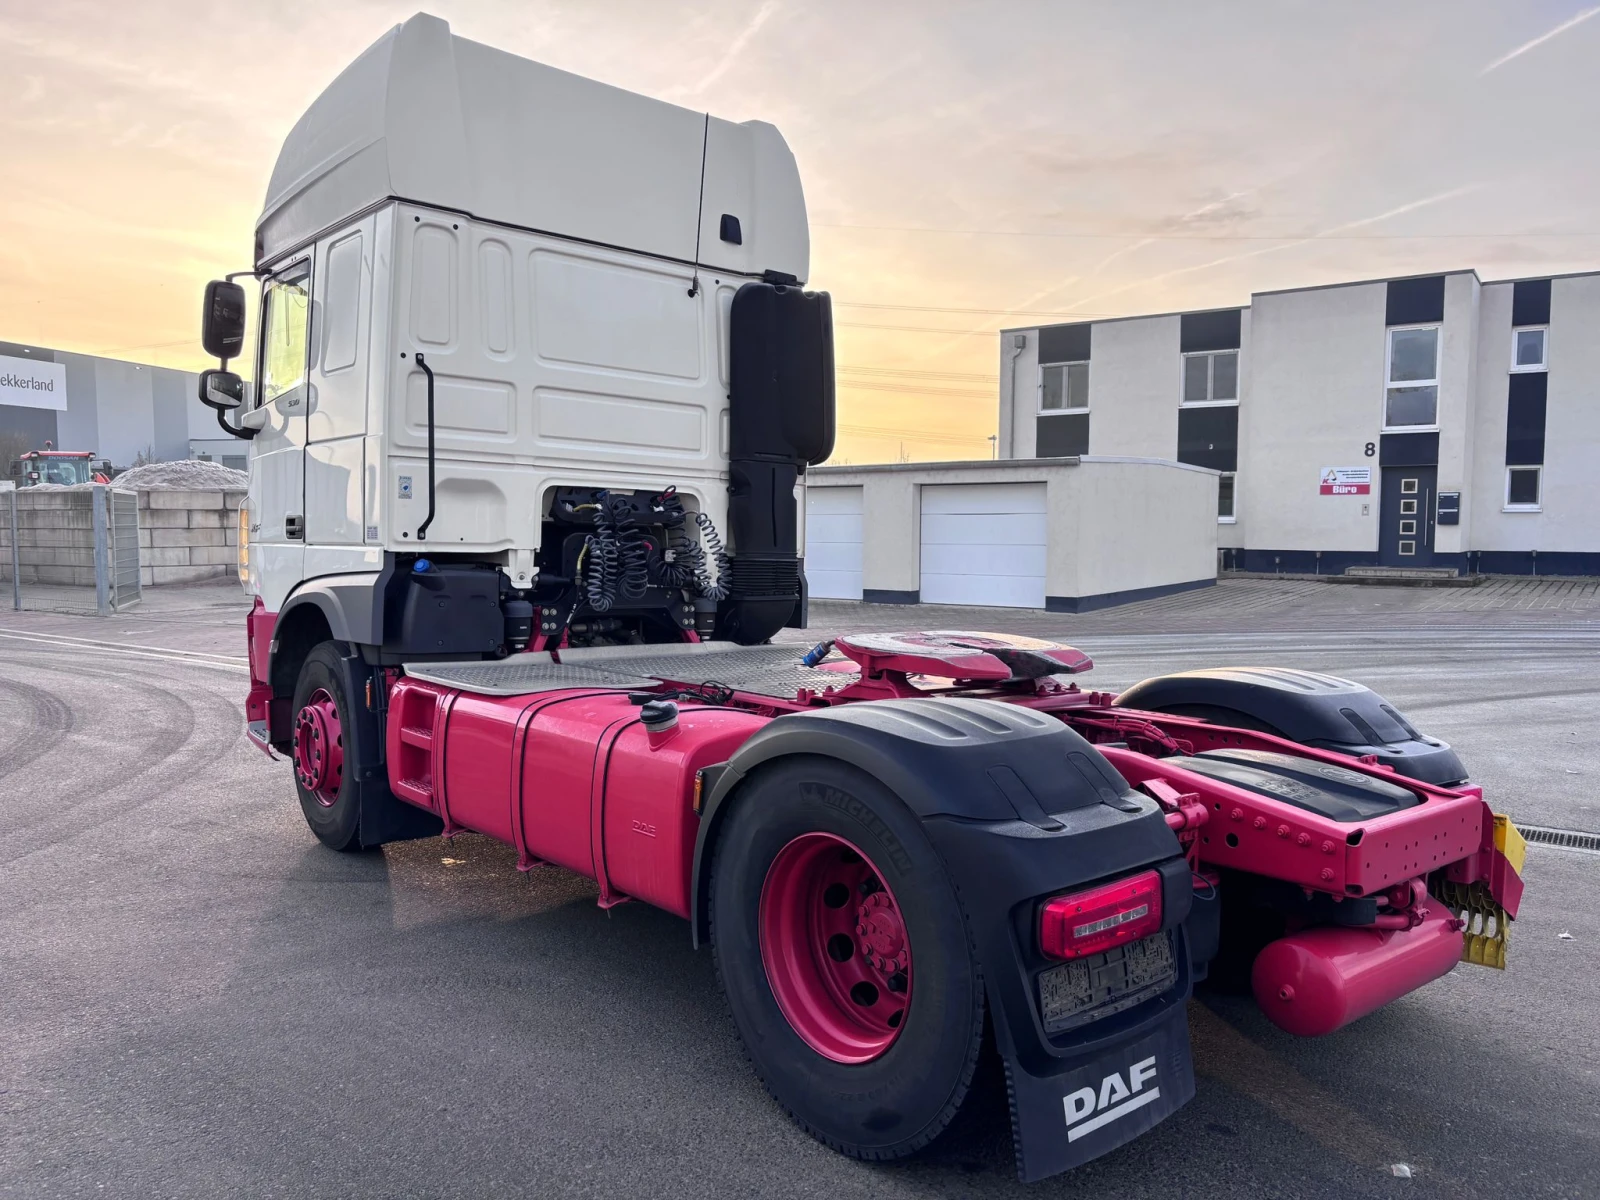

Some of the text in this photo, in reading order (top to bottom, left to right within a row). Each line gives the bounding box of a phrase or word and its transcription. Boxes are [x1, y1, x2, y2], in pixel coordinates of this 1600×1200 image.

[0, 373, 54, 391] ekkerland
[1364, 442, 1375, 457] 8
[1332, 485, 1357, 494] Büro
[824, 786, 912, 872] MICHELIN
[1063, 1055, 1157, 1126] DAF
